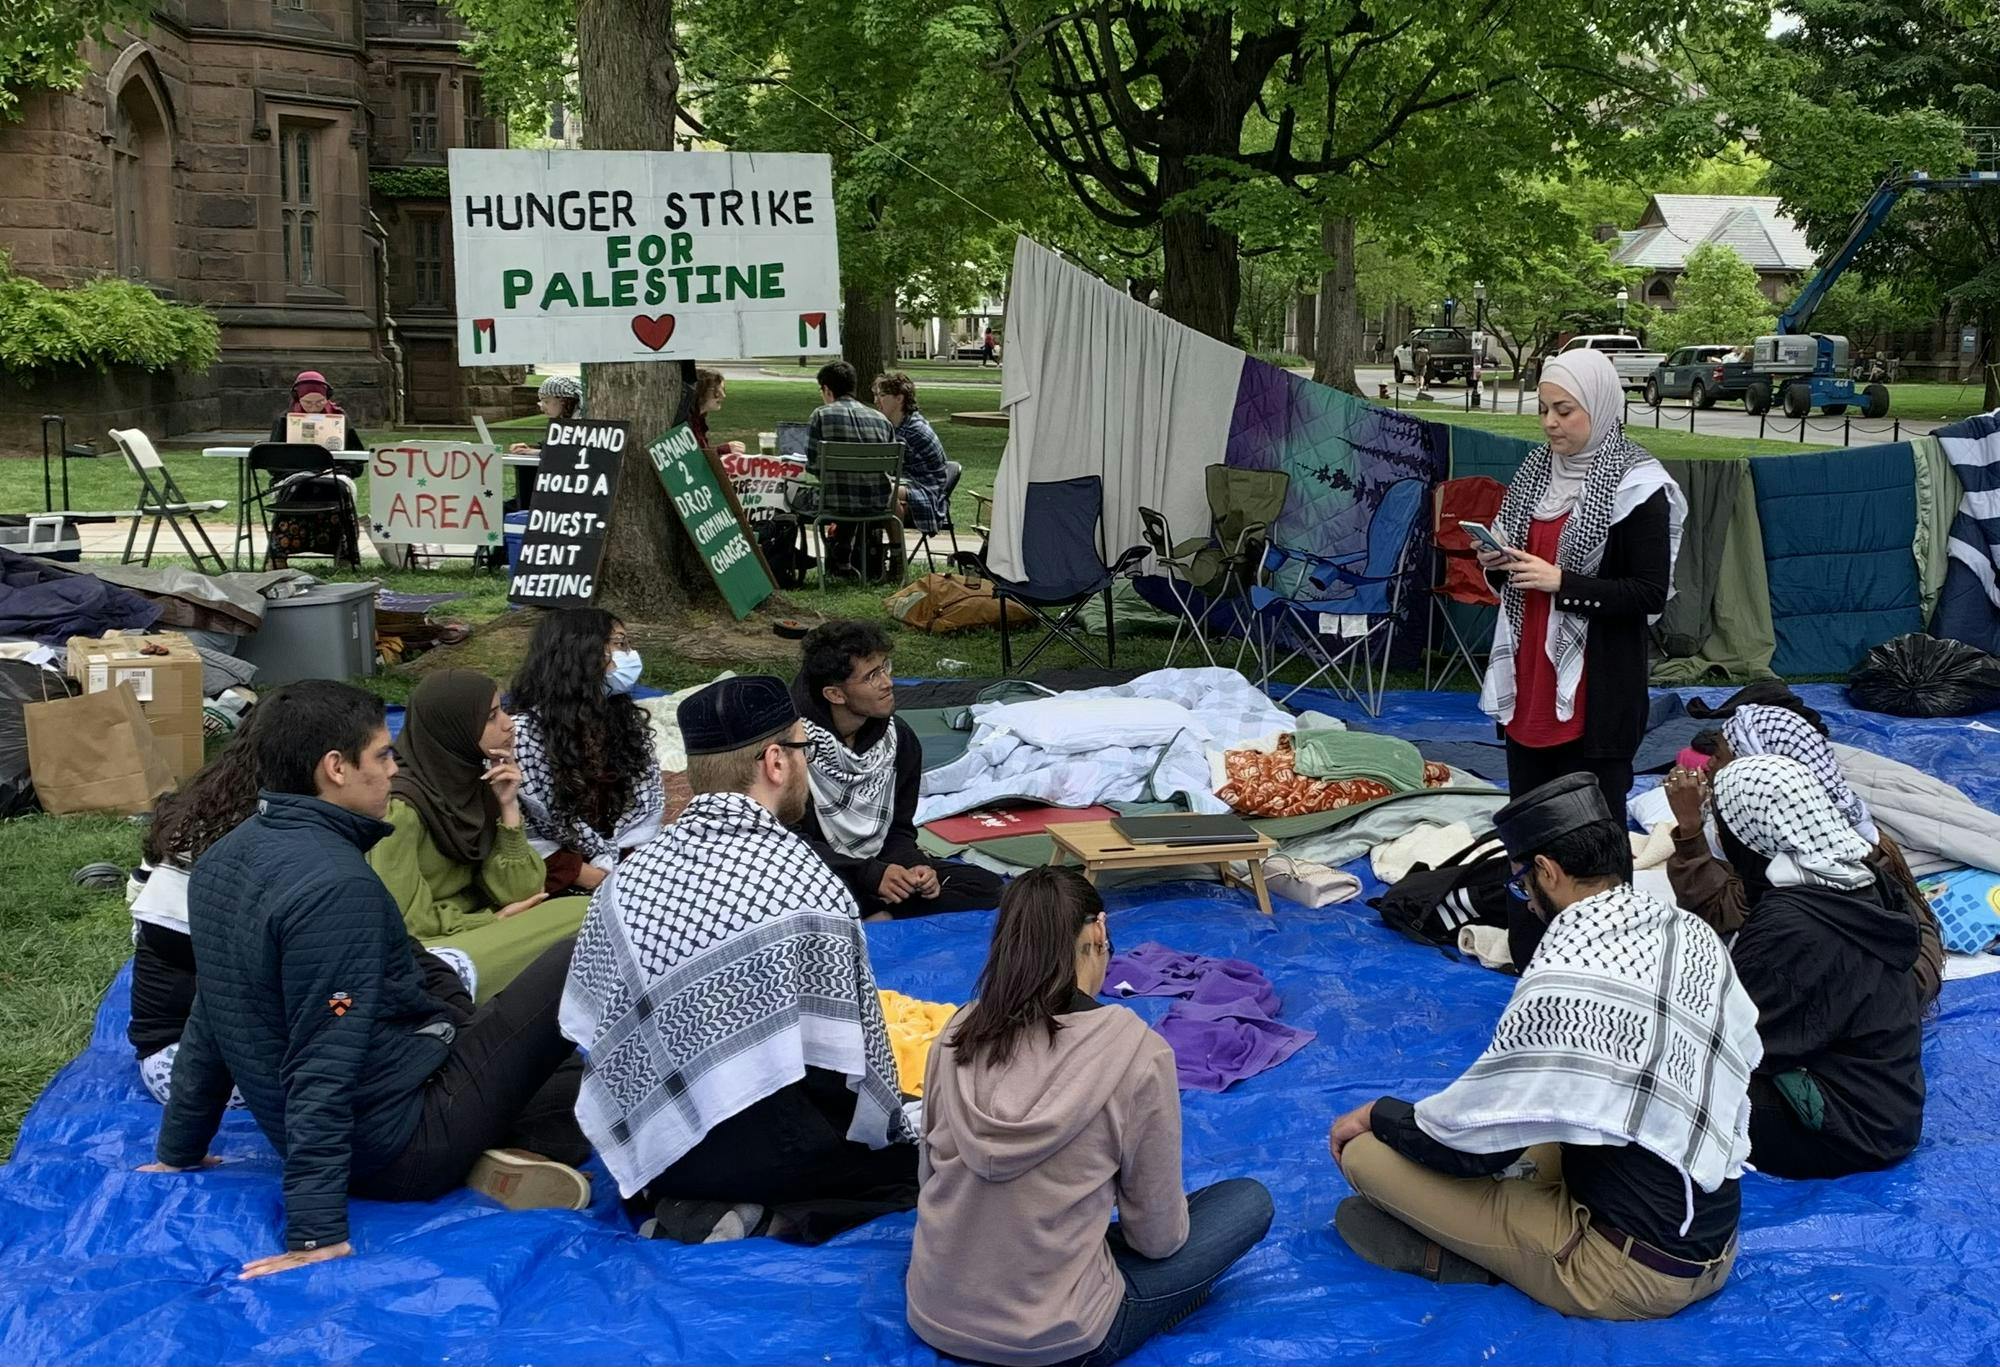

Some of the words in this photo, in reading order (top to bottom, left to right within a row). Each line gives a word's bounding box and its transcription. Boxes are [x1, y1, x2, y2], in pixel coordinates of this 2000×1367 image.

[465, 191, 637, 231] HUNGER
[664, 190, 814, 230] STRIKE
[606, 232, 694, 268] FOR
[503, 262, 786, 310] PALESTINE
[546, 423, 626, 452] DEMAND
[649, 426, 698, 472] DEMAND
[373, 447, 494, 486] STUDY
[574, 448, 590, 470] 1
[678, 460, 695, 486] 2
[723, 455, 804, 478] SUPPORT
[535, 473, 588, 495] HOLD
[592, 473, 609, 497] A
[741, 495, 762, 506] AND
[387, 493, 490, 530] AREA
[674, 485, 713, 520] DROP
[529, 509, 606, 537] DIVEST-
[694, 507, 737, 545] CRIMINAL
[519, 544, 581, 566] MENT
[710, 533, 751, 575] CHARGES
[509, 574, 593, 598] MEETING
